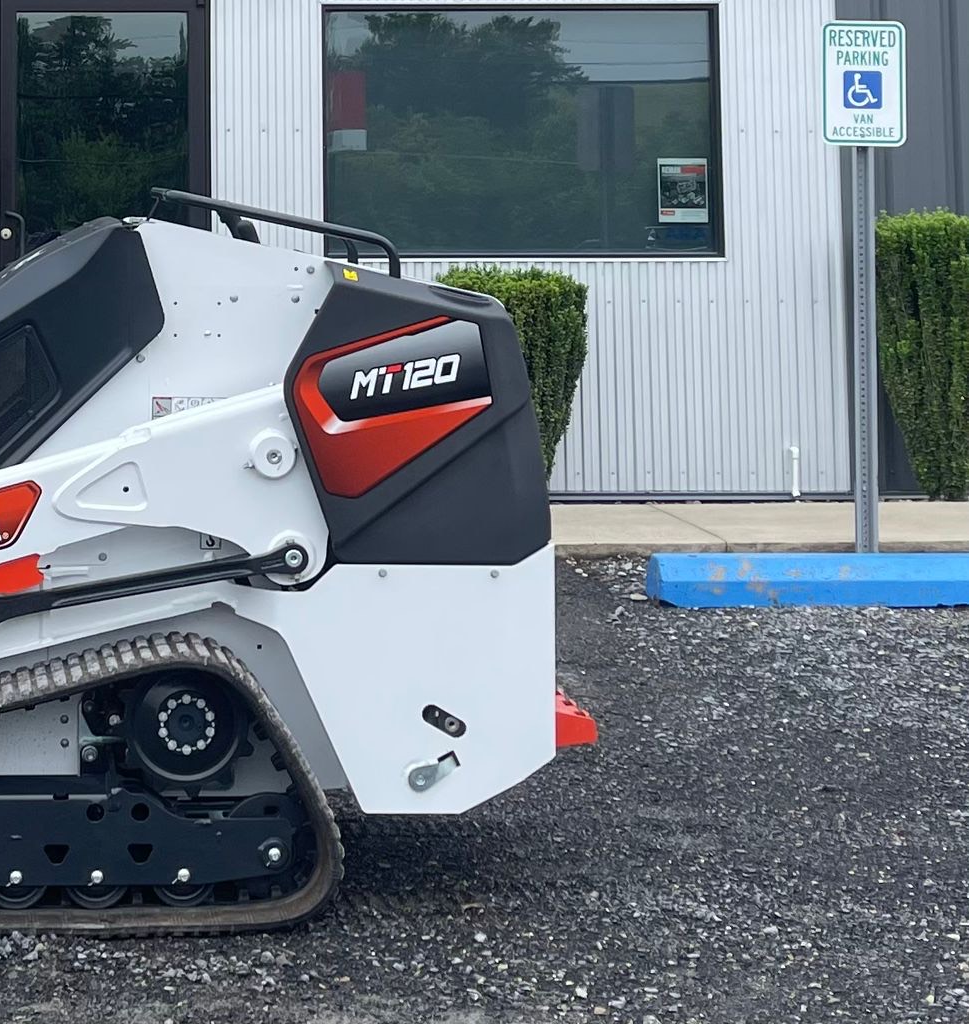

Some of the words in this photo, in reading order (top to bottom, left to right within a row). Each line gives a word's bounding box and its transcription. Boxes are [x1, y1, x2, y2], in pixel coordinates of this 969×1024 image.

[829, 29, 896, 48] RESERVED
[836, 50, 889, 66] PARKING
[853, 114, 874, 124] VAN
[832, 126, 895, 138] ACCESSIBLE
[349, 353, 461, 400] MT120
